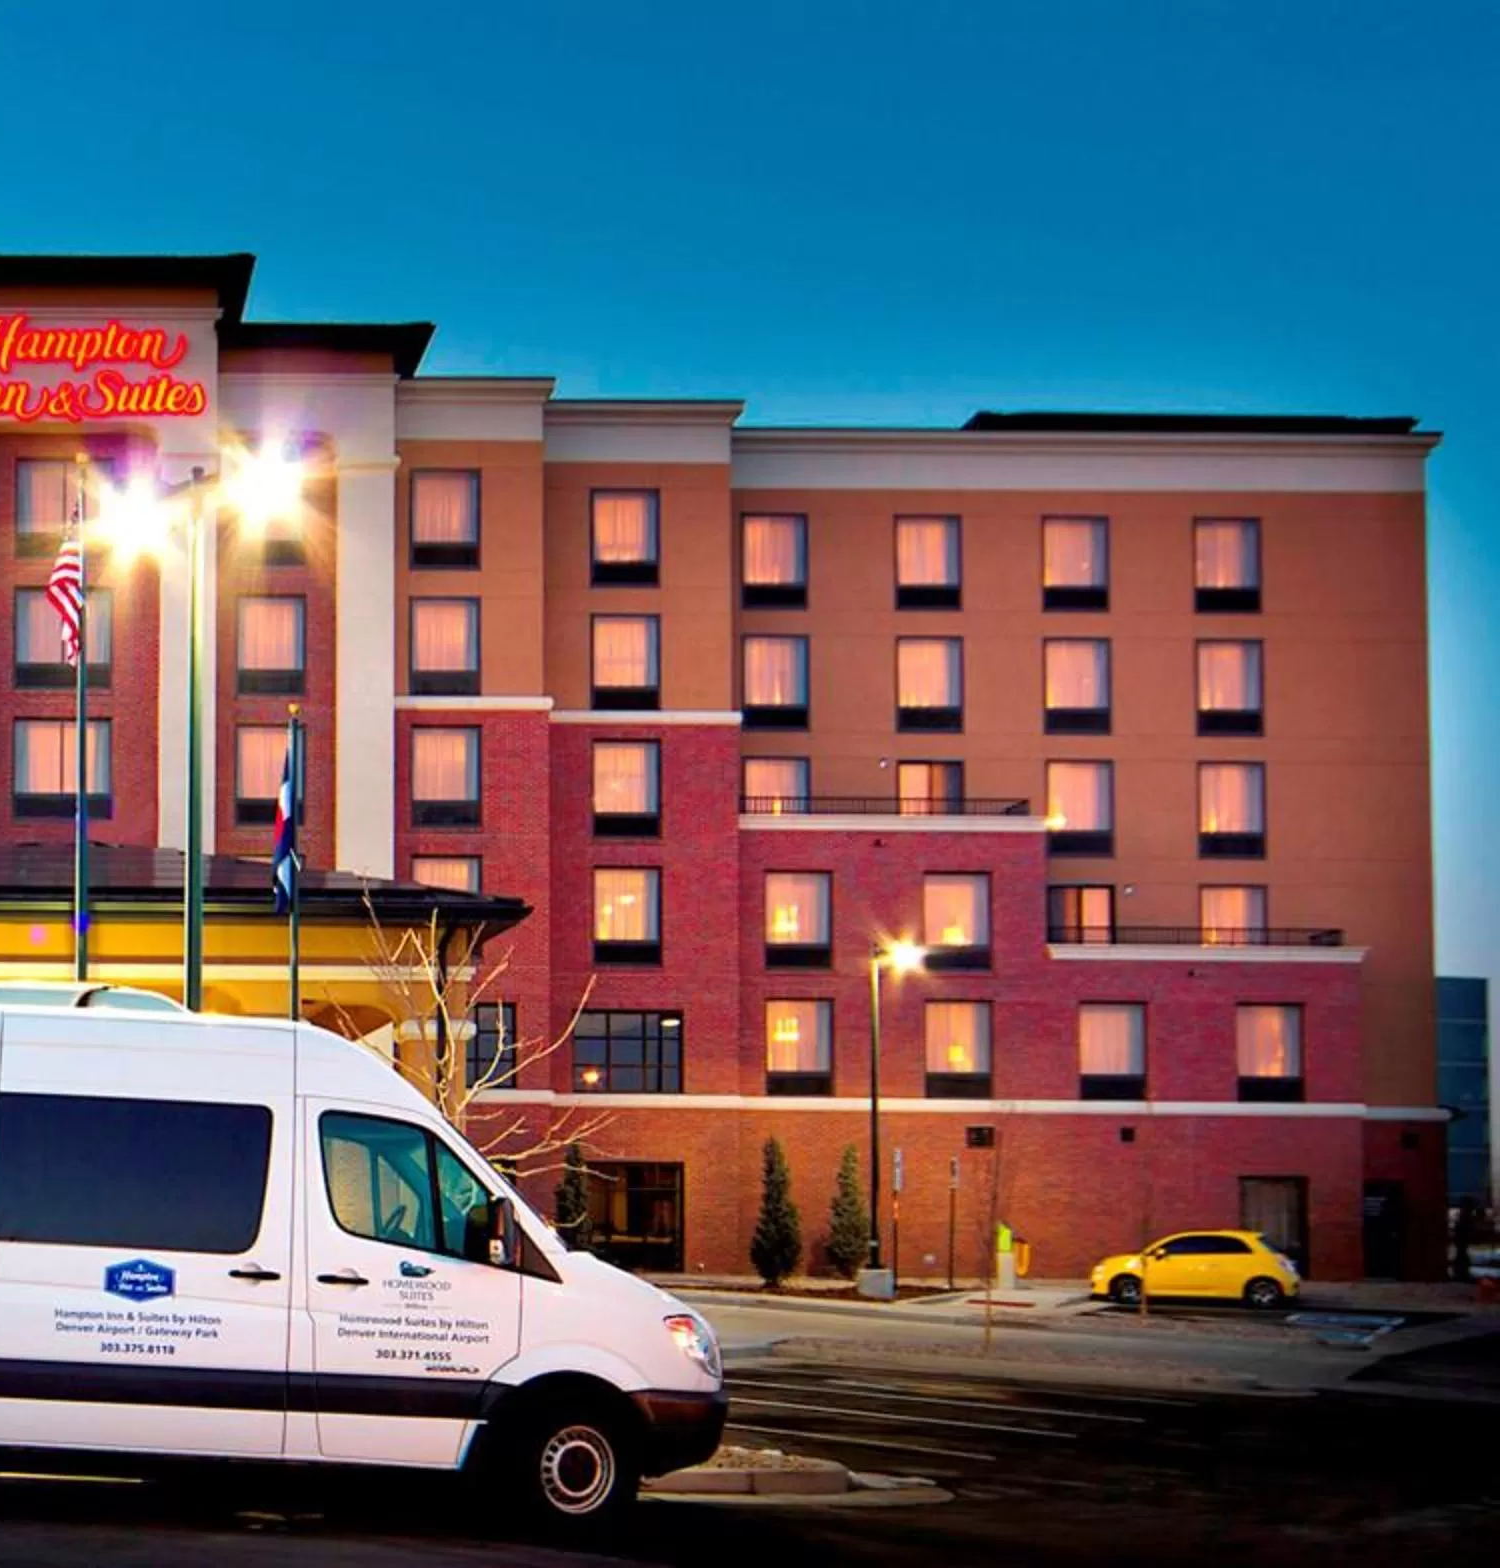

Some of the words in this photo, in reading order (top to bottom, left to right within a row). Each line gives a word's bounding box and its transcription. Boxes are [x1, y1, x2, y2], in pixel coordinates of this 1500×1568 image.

[47, 381, 83, 423] &
[77, 369, 208, 417] Suites
[382, 1280, 452, 1291] HOMEWOOD
[399, 1290, 435, 1301] SUITES
[54, 1308, 104, 1320] Hampton
[107, 1310, 125, 1320] Inn
[127, 1311, 135, 1321] &
[138, 1312, 169, 1323] Suites
[172, 1314, 185, 1325] by
[189, 1314, 221, 1325] Hilton
[339, 1312, 402, 1325] Homewood
[404, 1316, 437, 1327] Suites
[439, 1318, 452, 1330] by
[455, 1319, 489, 1330] Hilton
[55, 1321, 94, 1331] Denver
[97, 1324, 135, 1335] Airport
[145, 1326, 192, 1338] Gateway
[195, 1328, 218, 1338] Park
[337, 1327, 376, 1338] Denver
[378, 1329, 449, 1341] International
[451, 1333, 490, 1344] Airport
[375, 1348, 452, 1361] 303.371.4555
